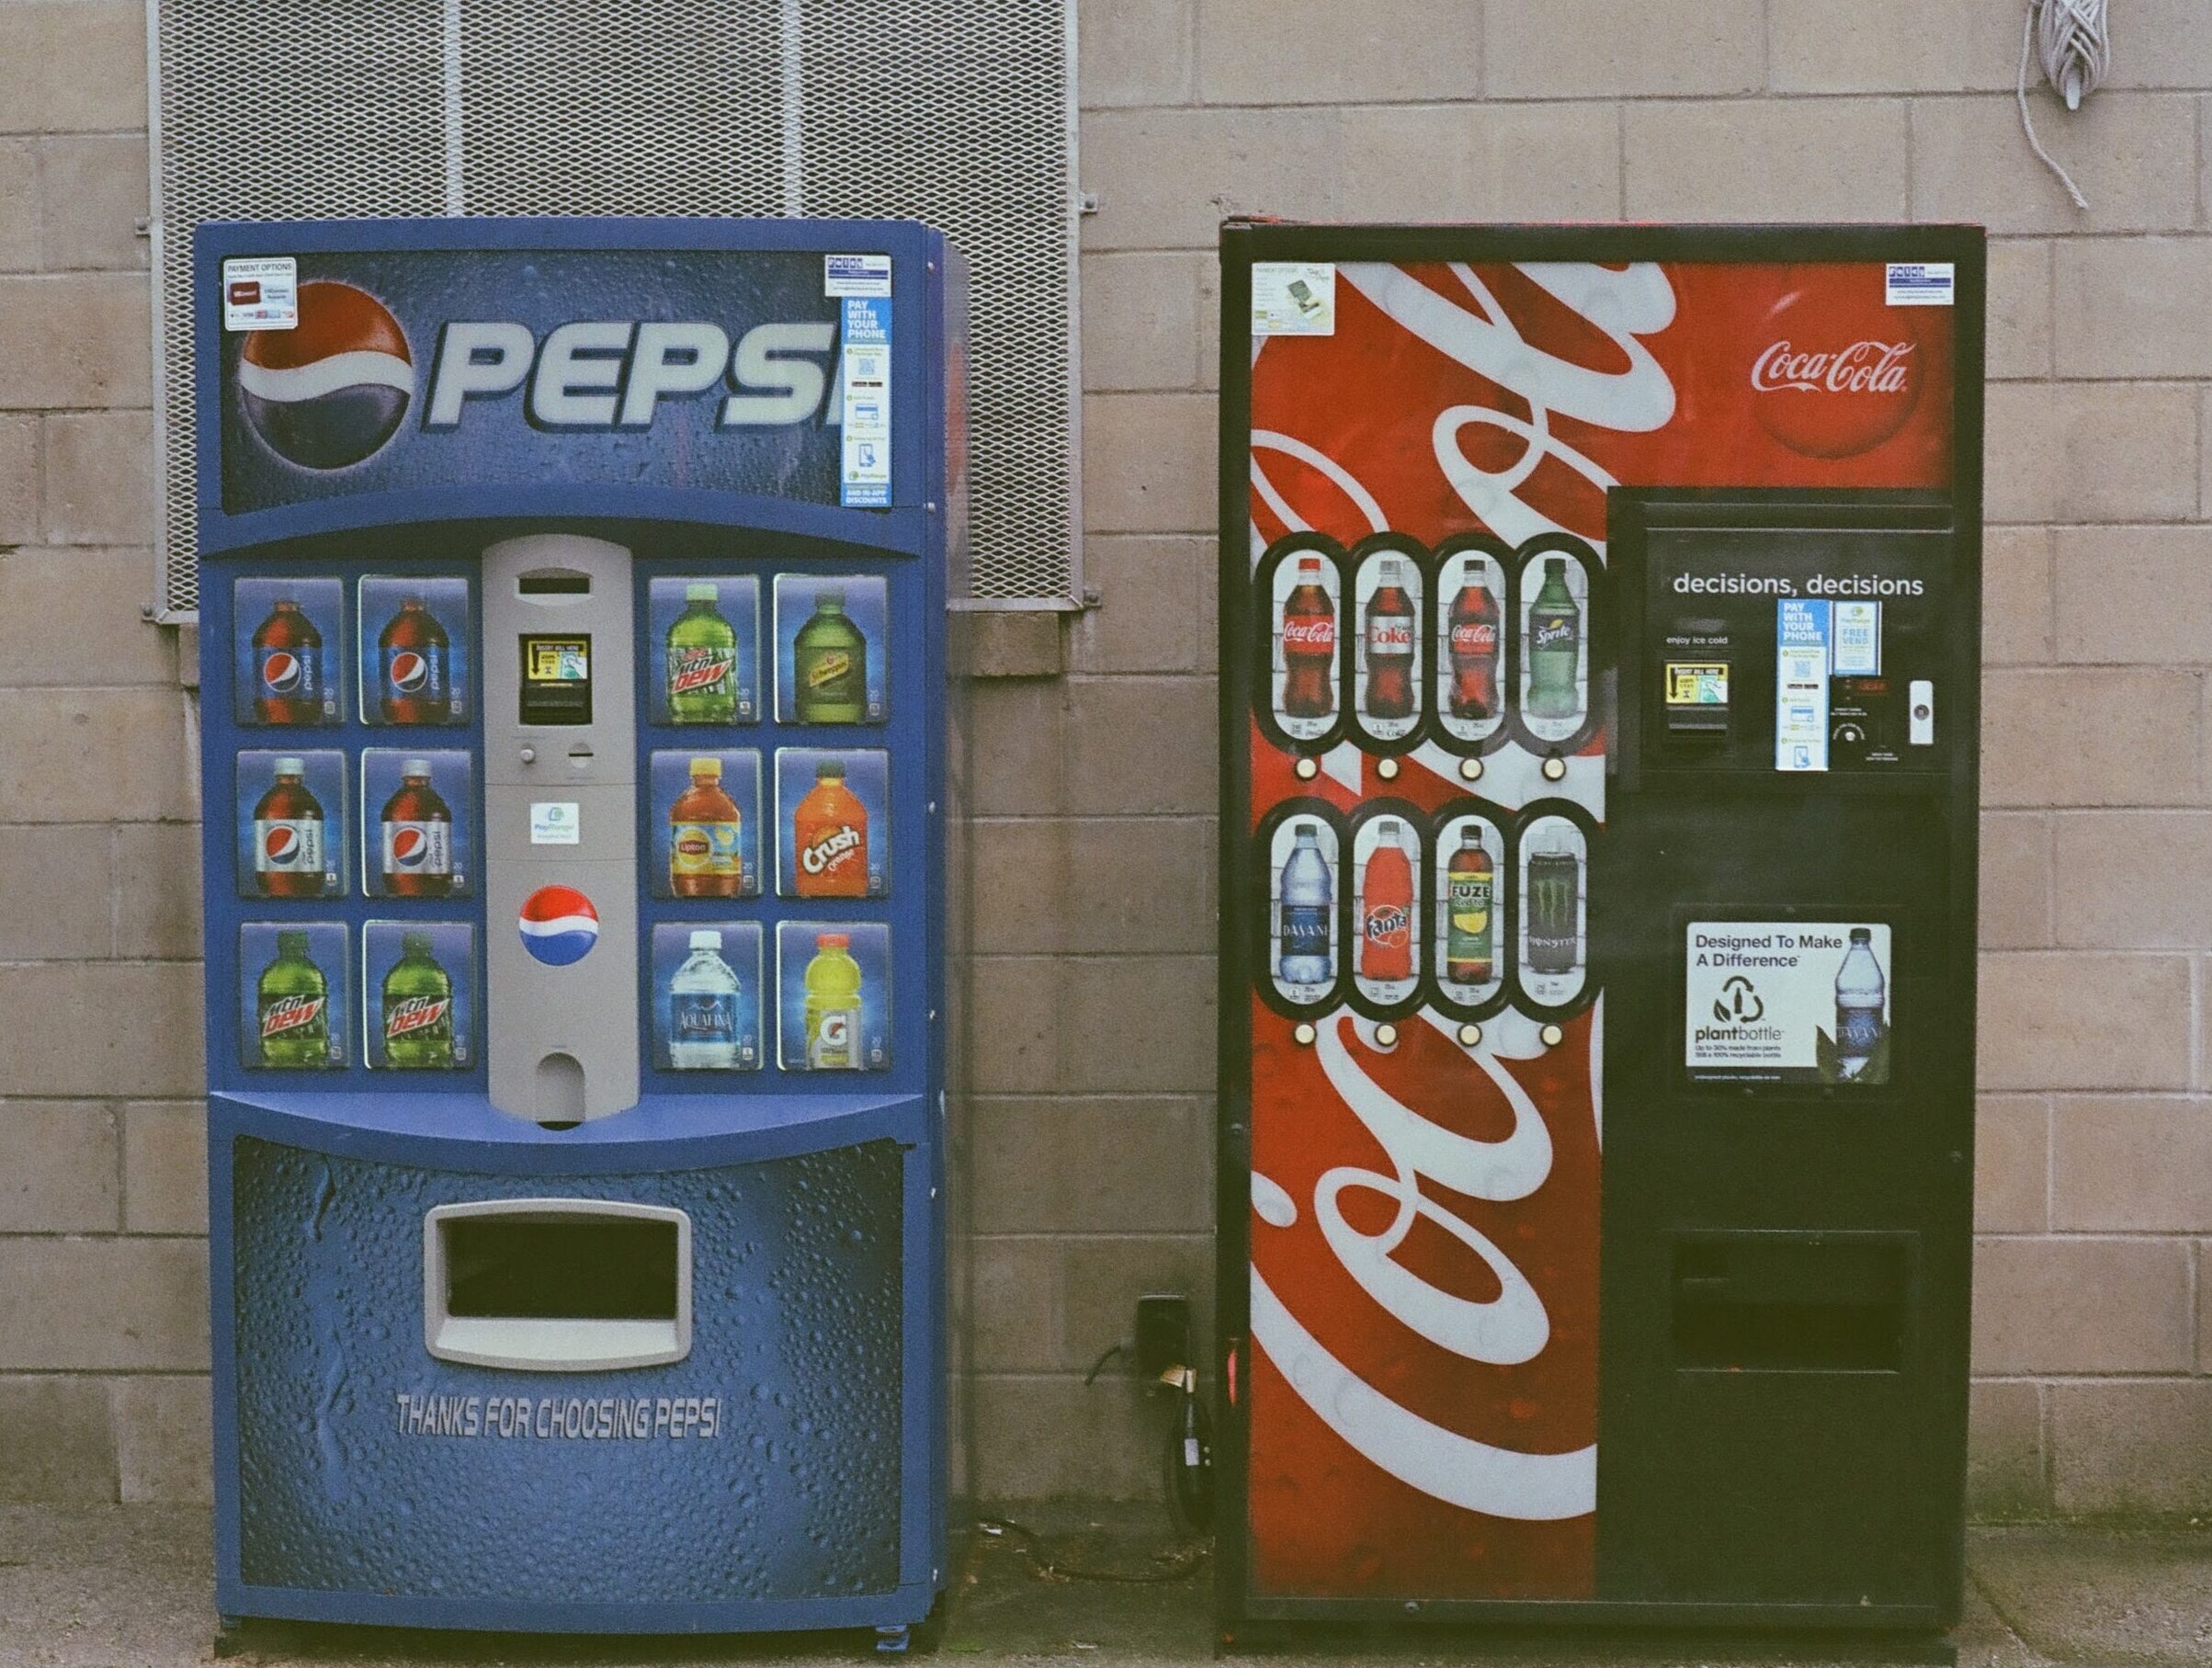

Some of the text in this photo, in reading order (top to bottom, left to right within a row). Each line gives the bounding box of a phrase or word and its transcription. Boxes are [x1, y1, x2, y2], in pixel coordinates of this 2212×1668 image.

[228, 263, 292, 273] PAYMENT OPTIONS
[847, 301, 868, 309] PAY
[847, 311, 876, 319] WITH
[847, 320, 878, 329] YOUR
[847, 330, 886, 339] PHONE
[1751, 340, 1917, 393] Coca-Cola
[1673, 573, 1923, 596] decisions, decisions
[1784, 603, 1804, 612] PAY
[1783, 613, 1812, 621] WITH
[1284, 621, 1333, 642] Coca-Cola
[1452, 624, 1496, 642] Coca-Cola
[1783, 622, 1814, 631] YOUR
[1367, 625, 1412, 643] Coke
[1537, 626, 1571, 644] Sprite
[1666, 636, 1690, 645] enjoy
[1783, 632, 1822, 641] PHONE
[681, 843, 707, 854] Lipton
[802, 825, 861, 874] Crush
[1451, 886, 1490, 897] FUZE
[1283, 924, 1329, 937] DASANI
[1696, 935, 1843, 950] Designed To Make
[1696, 954, 1708, 967] A
[681, 1012, 733, 1031] AQUAFINA
[821, 1015, 847, 1046] G
[1696, 1026, 1782, 1044] plantbottle
[397, 1394, 721, 1440] THANKS FOR CHOOSING PEPSI
